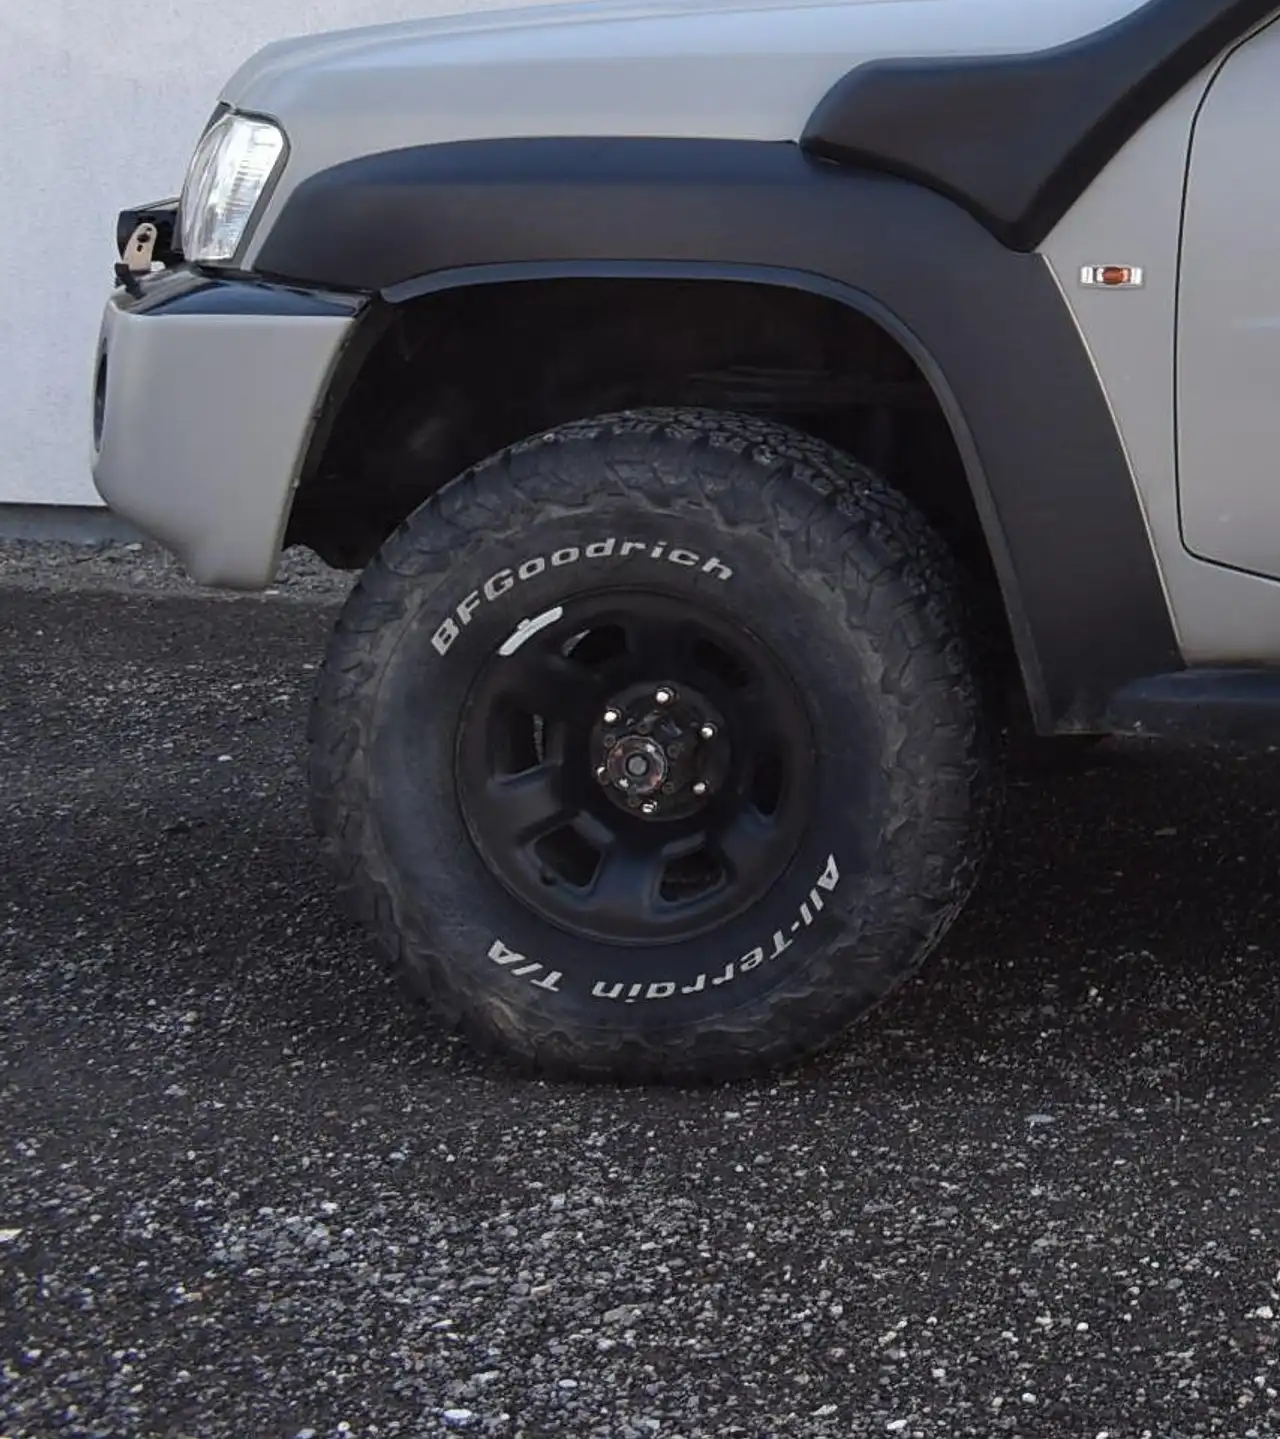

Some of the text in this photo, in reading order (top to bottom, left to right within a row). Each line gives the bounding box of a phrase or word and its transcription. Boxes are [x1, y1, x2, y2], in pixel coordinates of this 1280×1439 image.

[431, 536, 735, 657] BFGoodrich
[486, 853, 841, 1003] All-Terrain T/A
